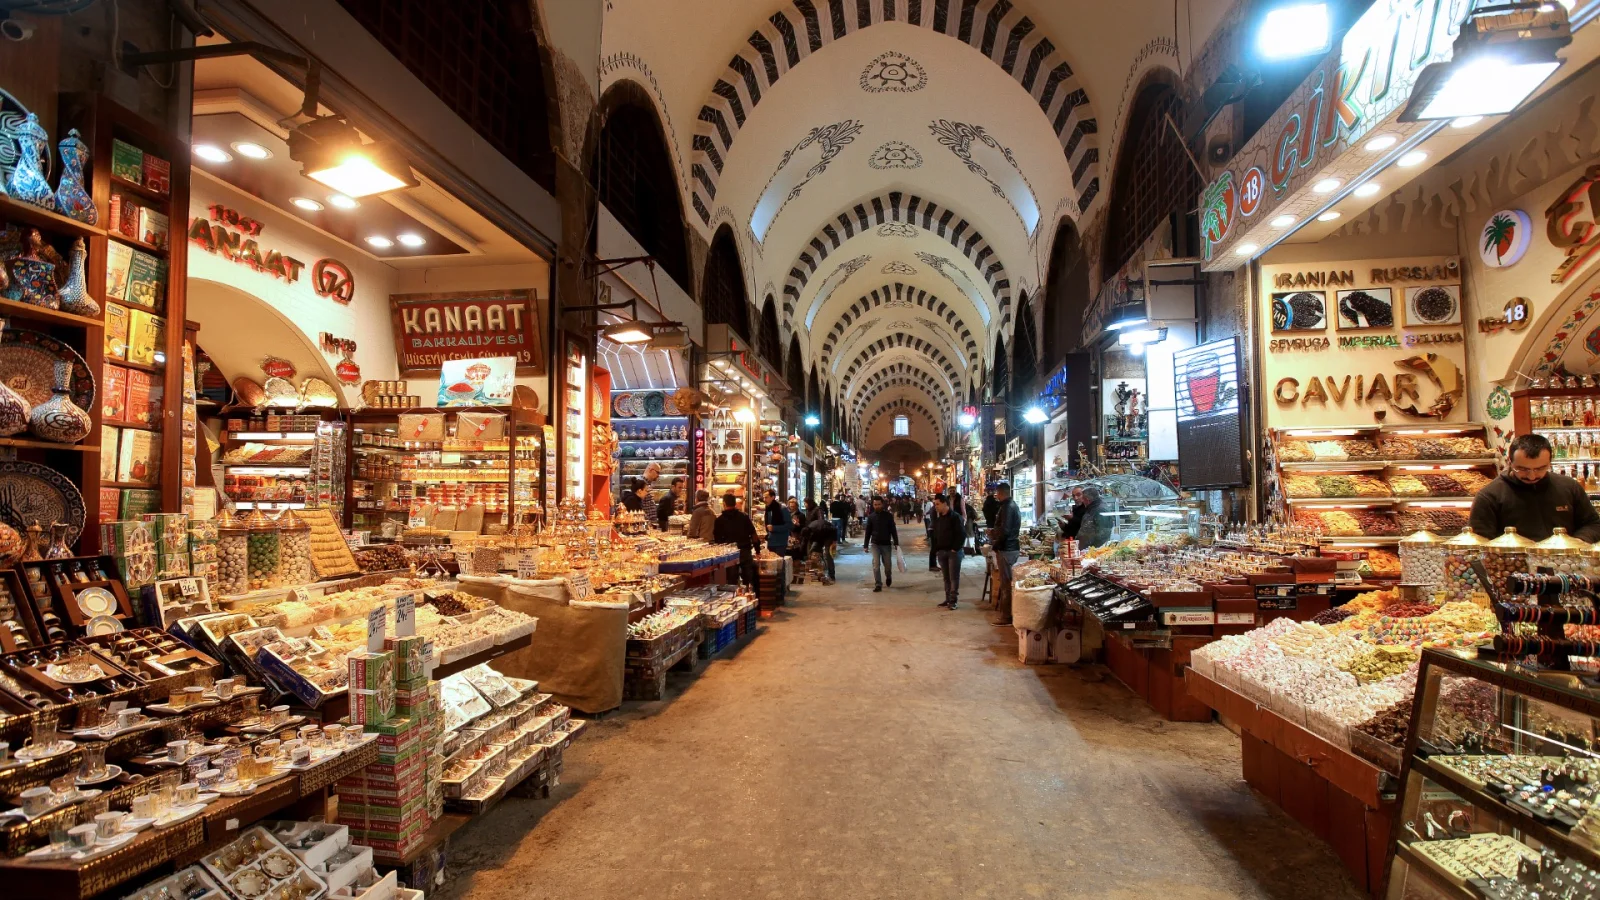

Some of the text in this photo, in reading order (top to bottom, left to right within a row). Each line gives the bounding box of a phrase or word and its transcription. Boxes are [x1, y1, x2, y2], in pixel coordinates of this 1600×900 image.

[1246, 175, 1258, 205] 18
[1273, 265, 1459, 288] IRANIAN RUSSIAN
[403, 303, 525, 334] KANAAT
[1505, 304, 1524, 323] 18
[1270, 332, 1464, 352] SEVRUGA IMPERIAL BELUGA
[1273, 371, 1420, 404] CAVIAR
